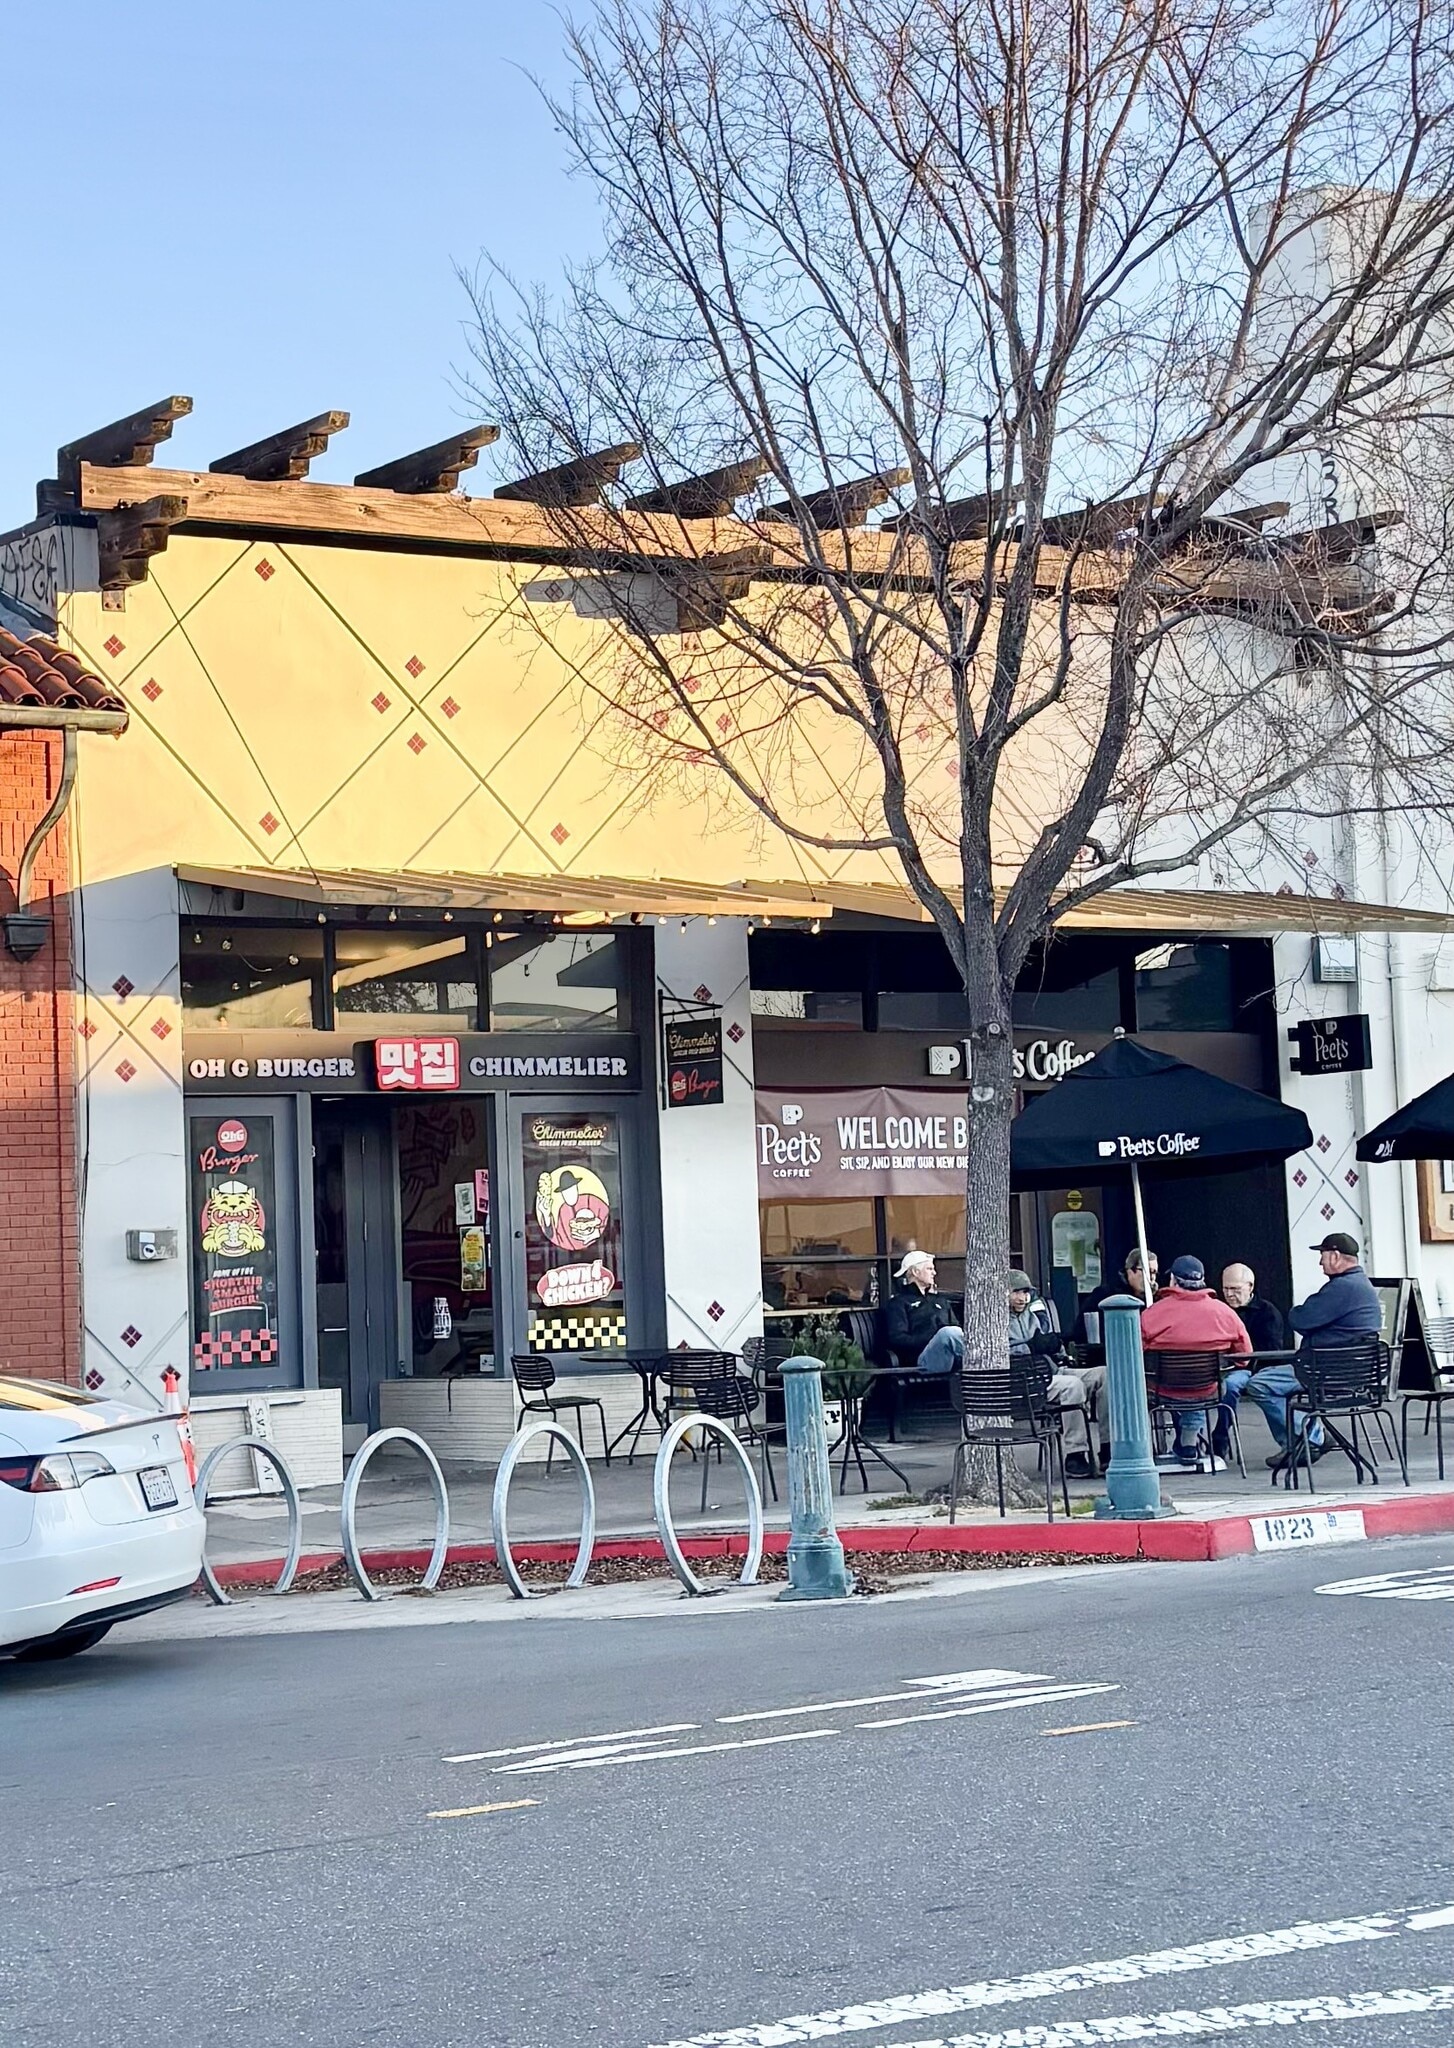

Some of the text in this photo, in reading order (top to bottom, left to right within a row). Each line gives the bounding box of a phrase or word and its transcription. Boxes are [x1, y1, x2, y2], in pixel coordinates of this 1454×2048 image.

[189, 1058, 356, 1078] OH G BURGER
[379, 1042, 455, 1085] 맛집
[469, 1056, 628, 1077] CHIMMELIER
[756, 1123, 821, 1166] Peet's
[837, 1116, 948, 1150] WELCOME
[1117, 1132, 1200, 1157] Peet's Coffee
[200, 1146, 259, 1174] Burger
[872, 1156, 890, 1169] AND
[917, 1155, 935, 1169] OUR
[936, 1155, 955, 1169] NEW
[203, 1277, 243, 1290] SHORT
[547, 1266, 592, 1288] DOWN
[543, 1276, 611, 1304] CHICKEN?
[1264, 1517, 1315, 1542] 1823
